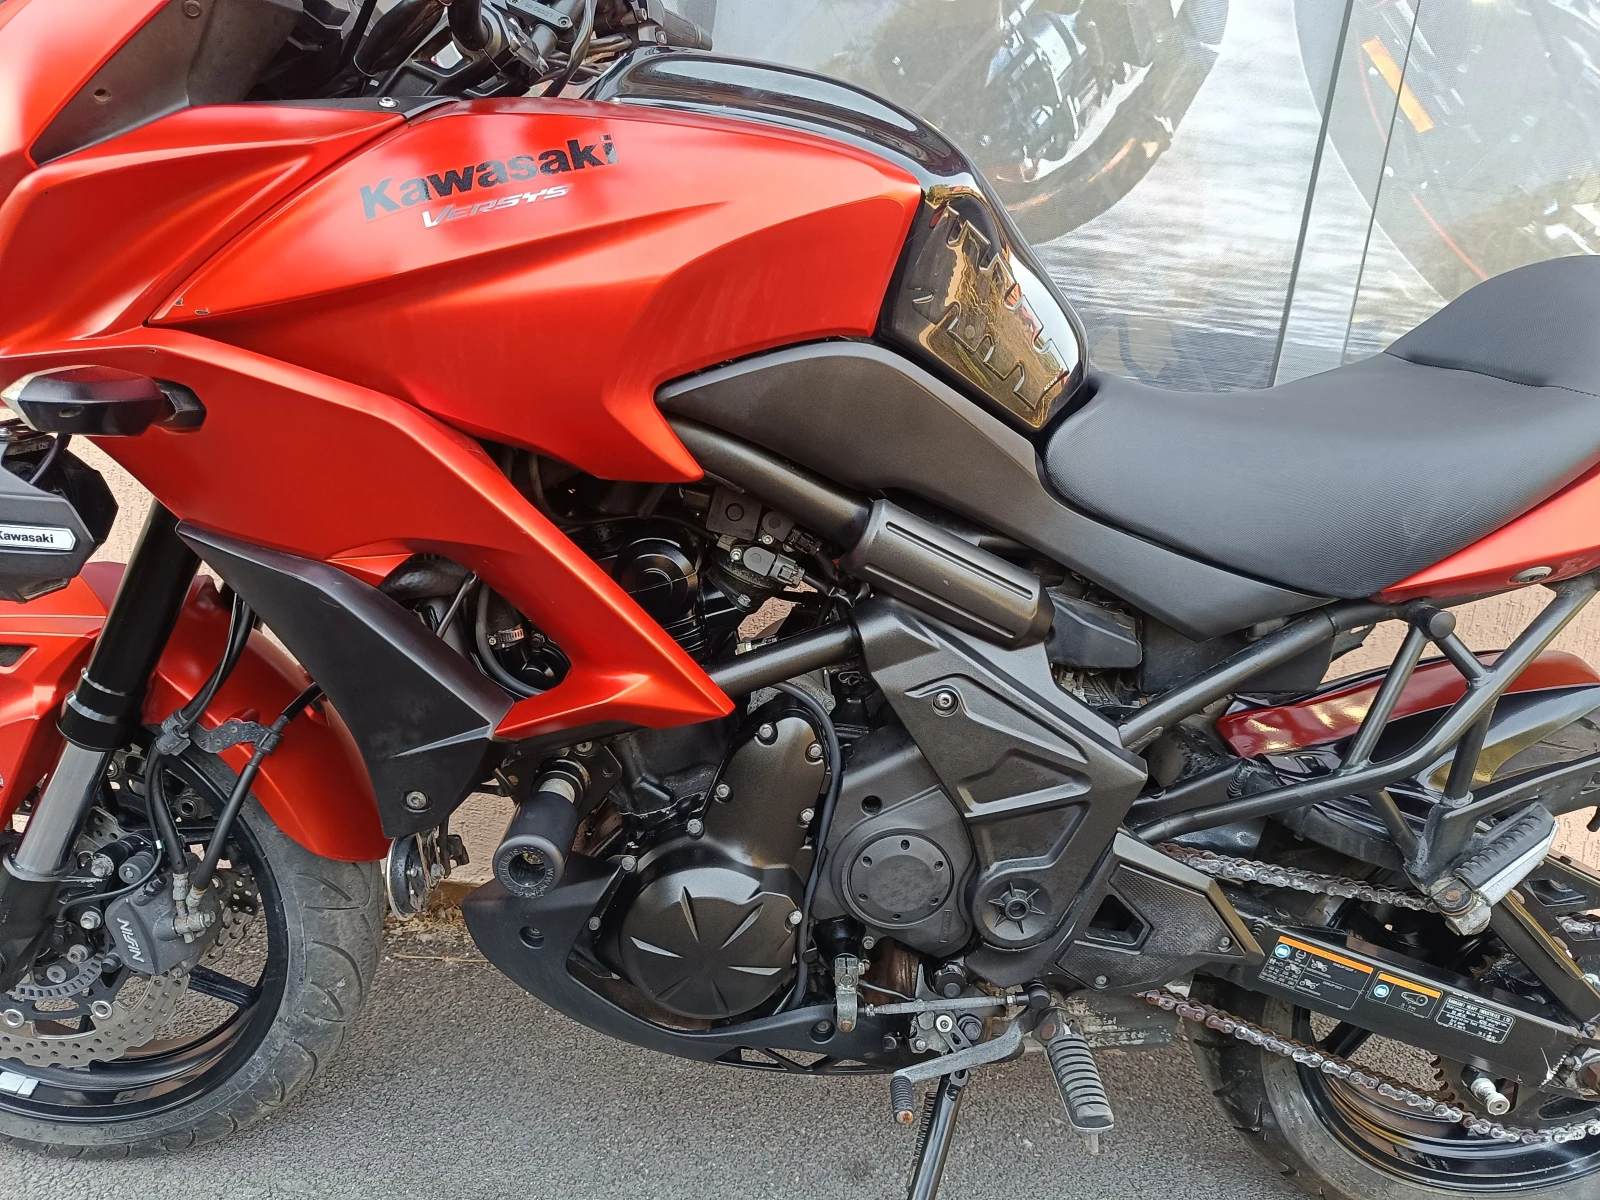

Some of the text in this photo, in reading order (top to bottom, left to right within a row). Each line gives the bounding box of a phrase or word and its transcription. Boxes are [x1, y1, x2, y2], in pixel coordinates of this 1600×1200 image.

[360, 134, 619, 220] Kawasaki
[422, 185, 570, 228] VERSYS
[117, 918, 145, 962] NISSIN
